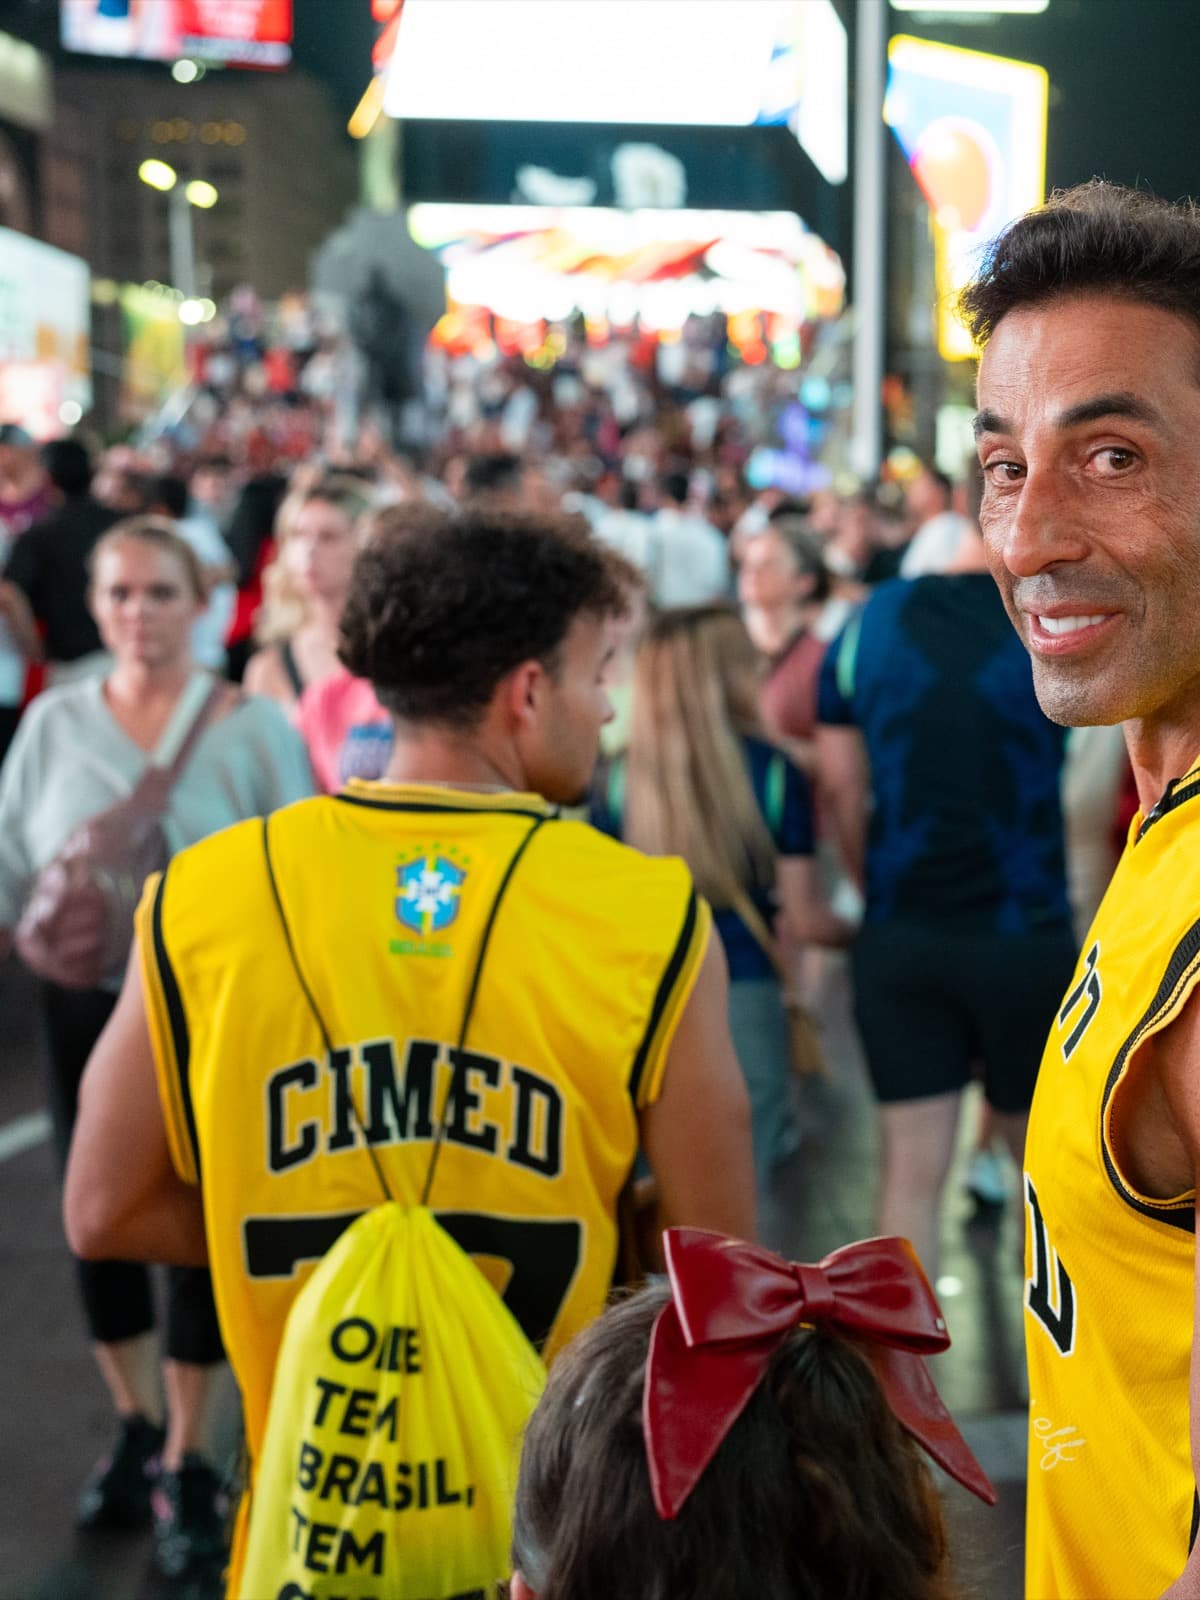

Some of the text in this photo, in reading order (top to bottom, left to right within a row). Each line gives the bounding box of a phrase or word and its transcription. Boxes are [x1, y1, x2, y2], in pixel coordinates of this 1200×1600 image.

[266, 1038, 564, 1179] CIMED
[298, 1442, 474, 1511] BRASIL,
[292, 1504, 386, 1576] TEM
